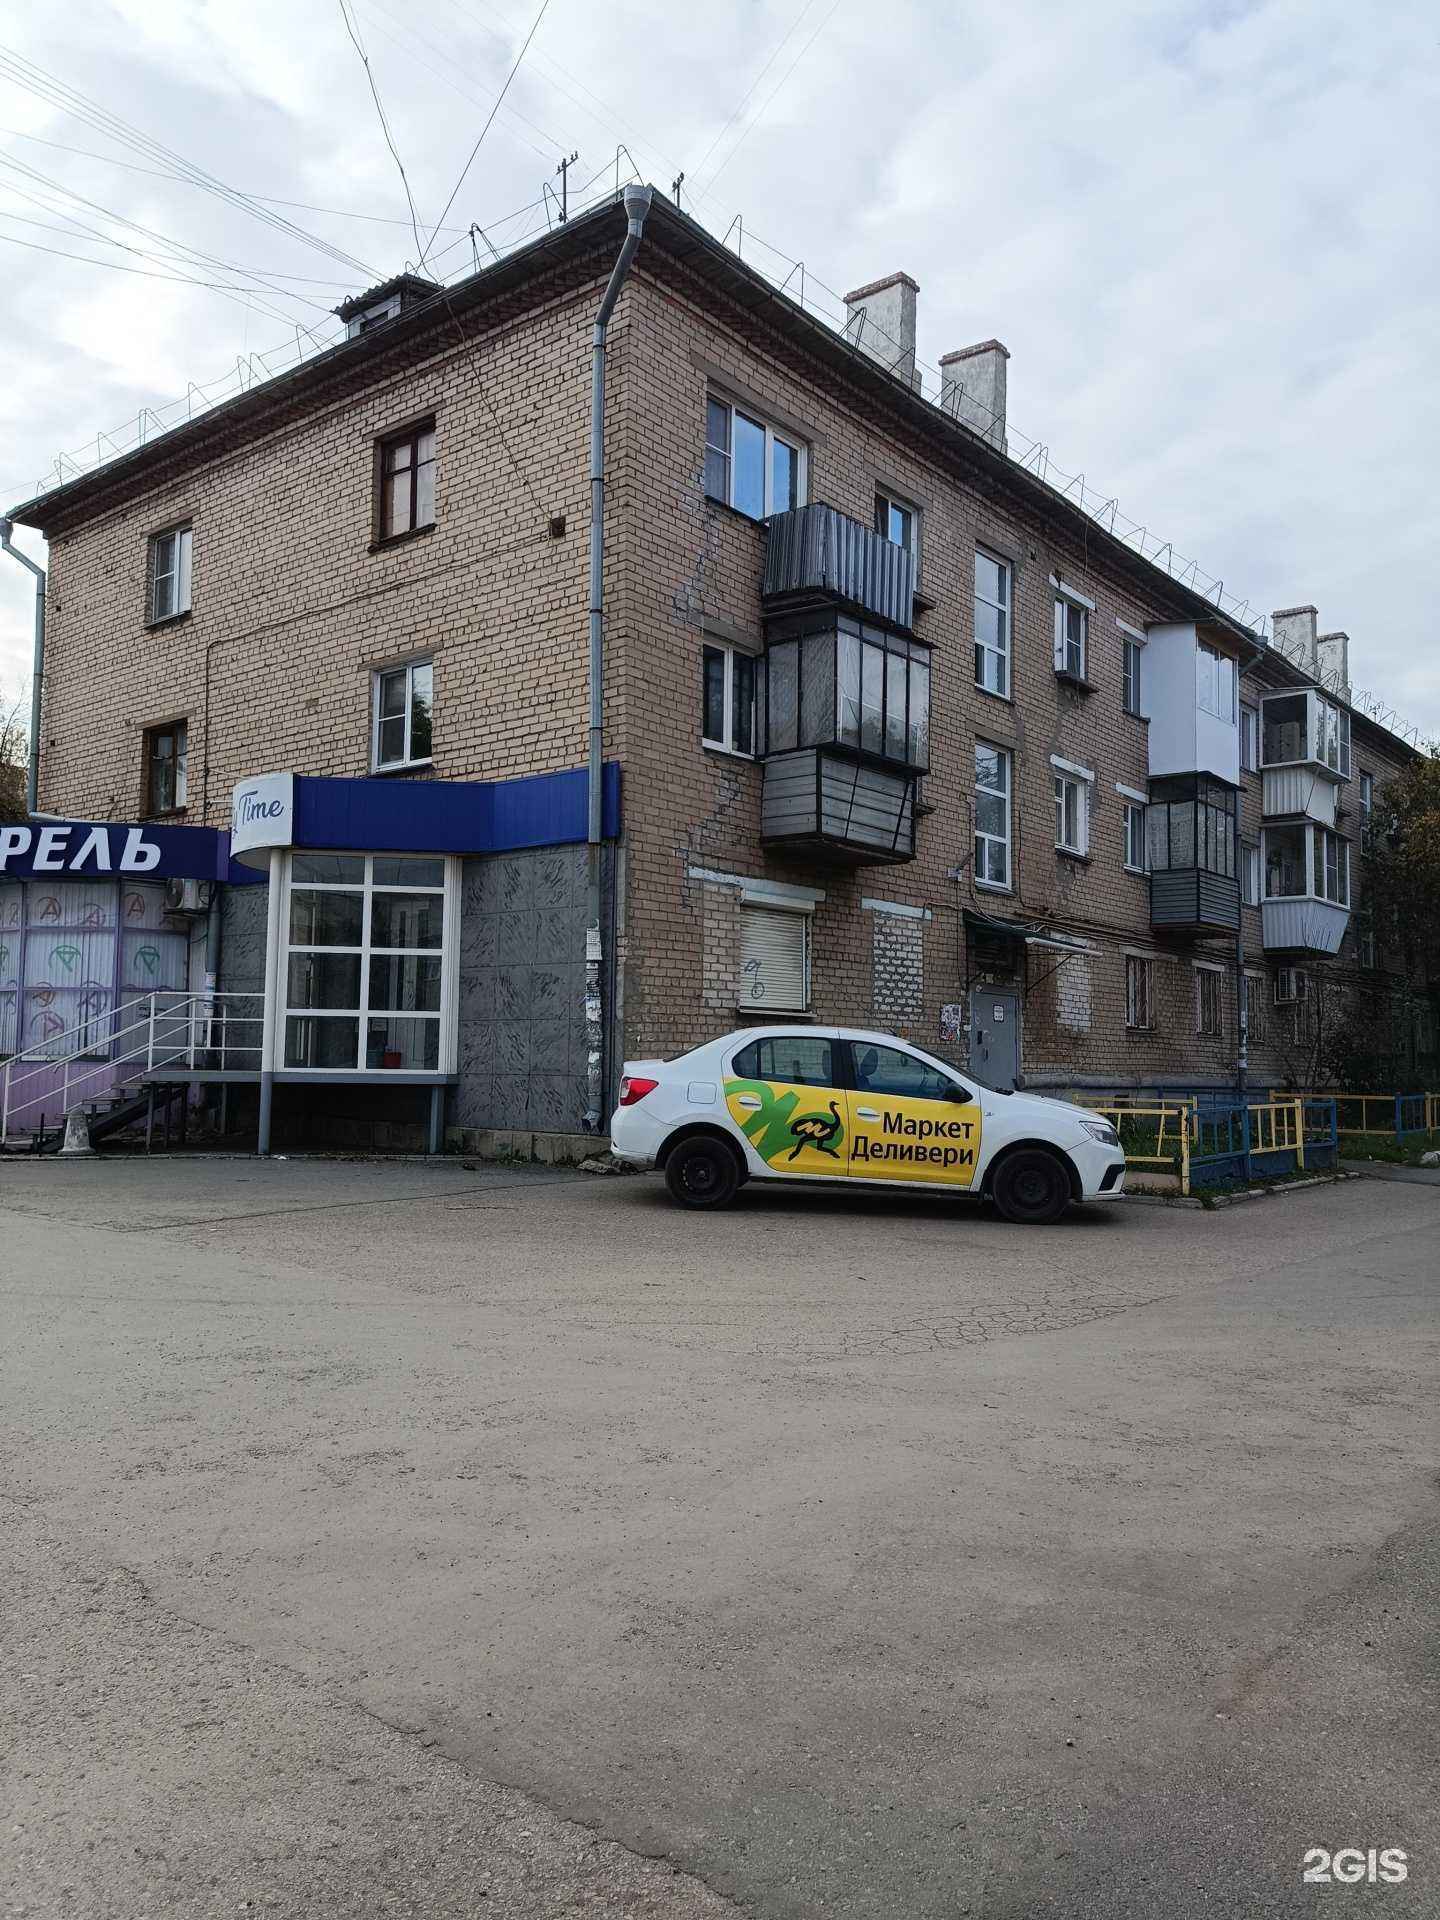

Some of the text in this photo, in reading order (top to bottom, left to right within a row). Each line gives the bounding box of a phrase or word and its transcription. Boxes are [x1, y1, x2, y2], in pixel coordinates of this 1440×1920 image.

[238, 790, 285, 825] Time
[883, 1111, 974, 1140] Маркет
[851, 1135, 973, 1167] Деливери
